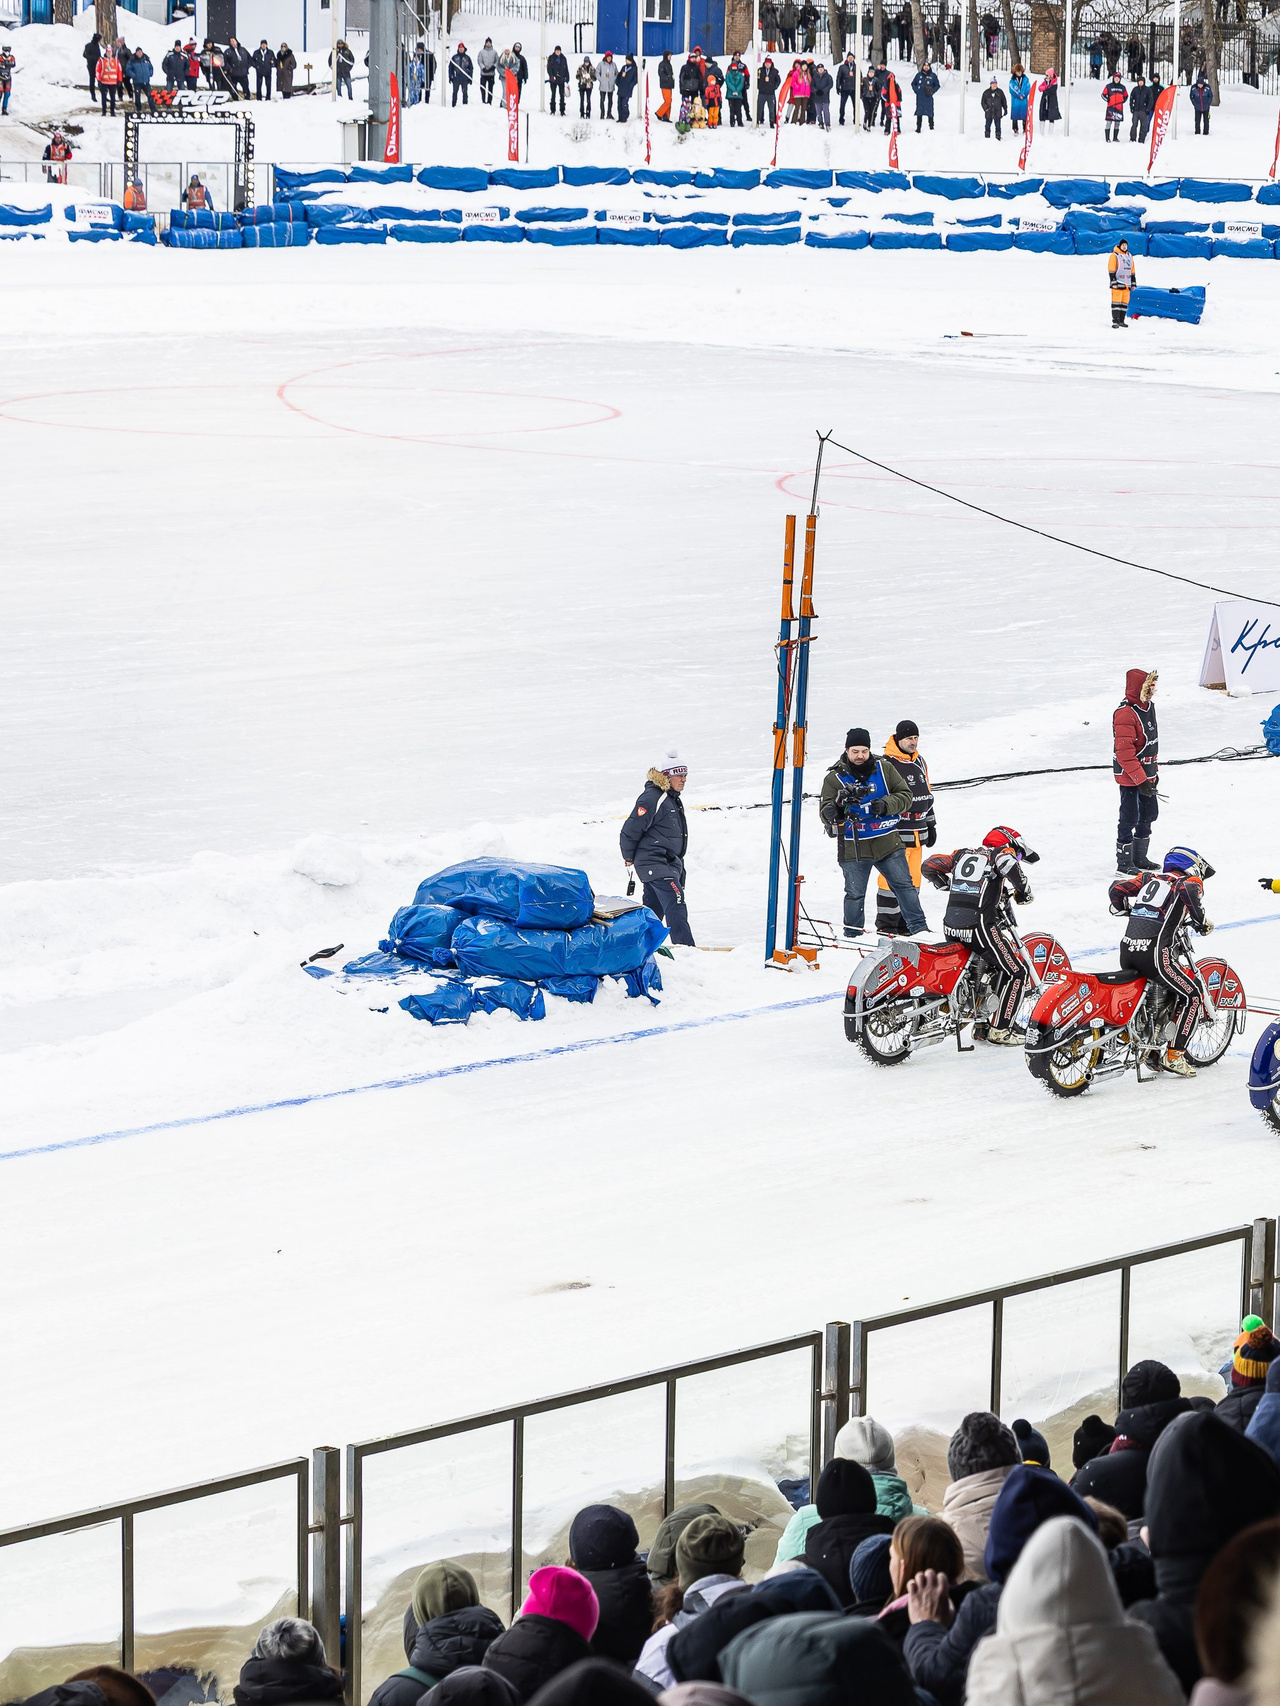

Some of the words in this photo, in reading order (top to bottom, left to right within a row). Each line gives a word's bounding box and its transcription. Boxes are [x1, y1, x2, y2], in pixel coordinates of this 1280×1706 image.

[171, 90, 231, 106] RGP
[609, 214, 641, 222] ФМСМО
[1022, 220, 1053, 230] ФМСМО
[961, 856, 979, 878] 6
[1142, 880, 1160, 902] 9
[944, 926, 973, 938] STOMIN
